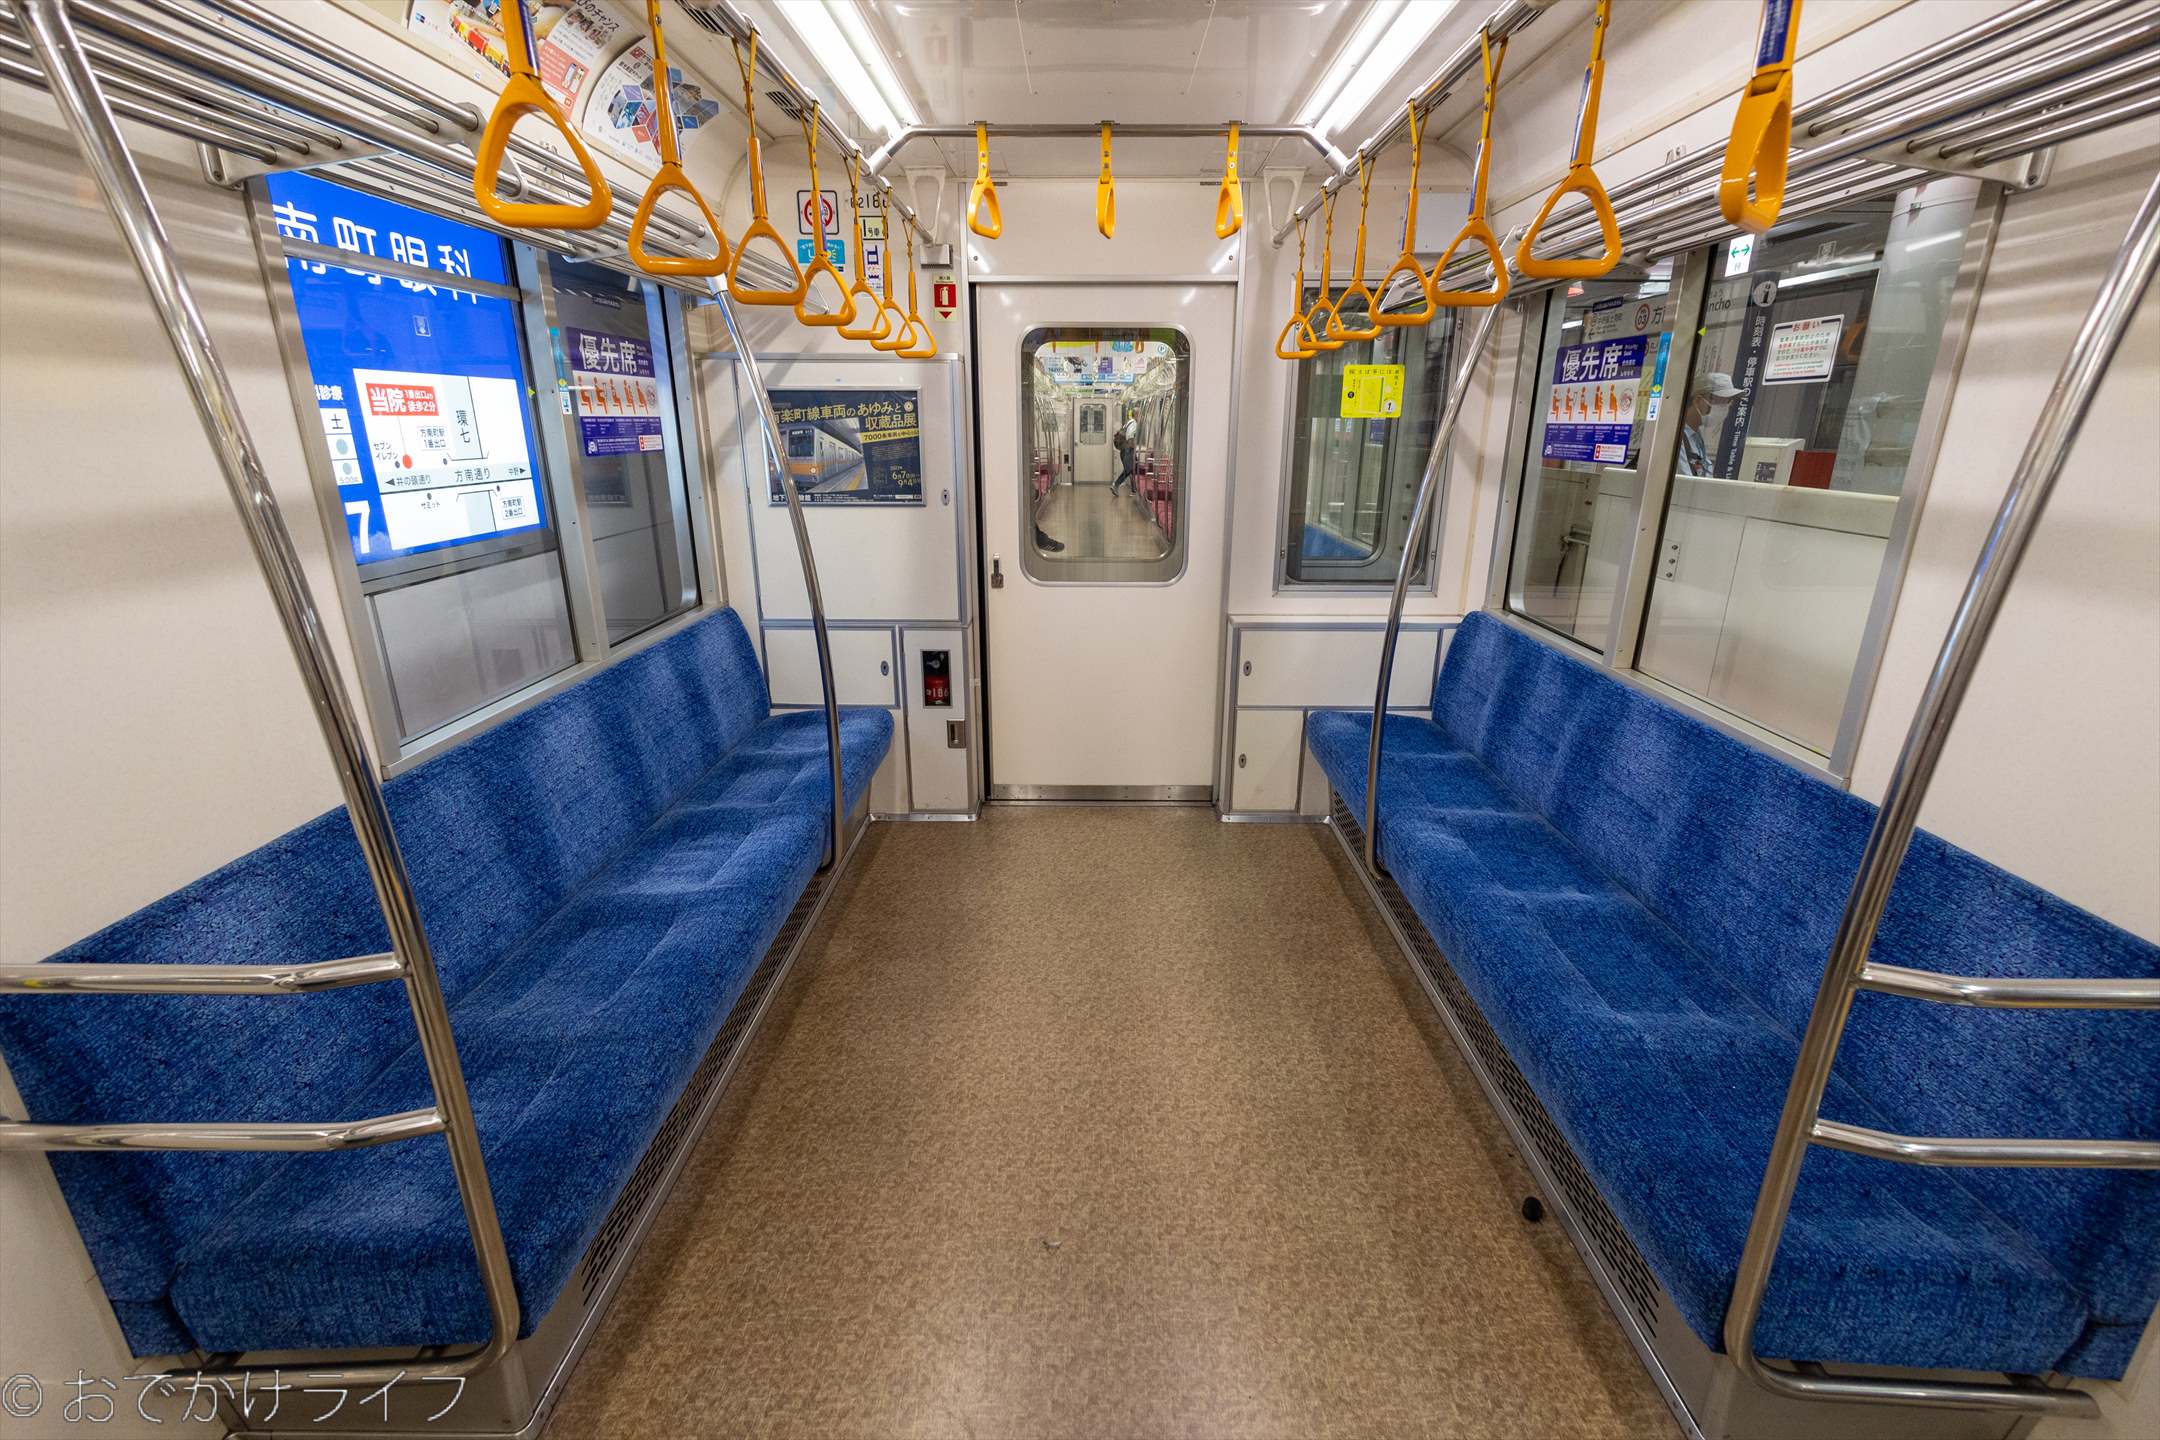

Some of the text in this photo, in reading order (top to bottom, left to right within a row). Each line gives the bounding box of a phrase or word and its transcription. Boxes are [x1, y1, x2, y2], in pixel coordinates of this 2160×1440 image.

[1637, 314, 1648, 326] 03
[579, 333, 637, 374] 優先席
[1562, 343, 1623, 382] 優先席
[370, 386, 407, 413] 当院
[331, 414, 344, 429] 土
[455, 409, 471, 443] 環七
[865, 413, 917, 431] 収蔵品展
[373, 442, 391, 451] セブン
[375, 451, 398, 461] イレブン
[454, 467, 491, 483] 方南通り
